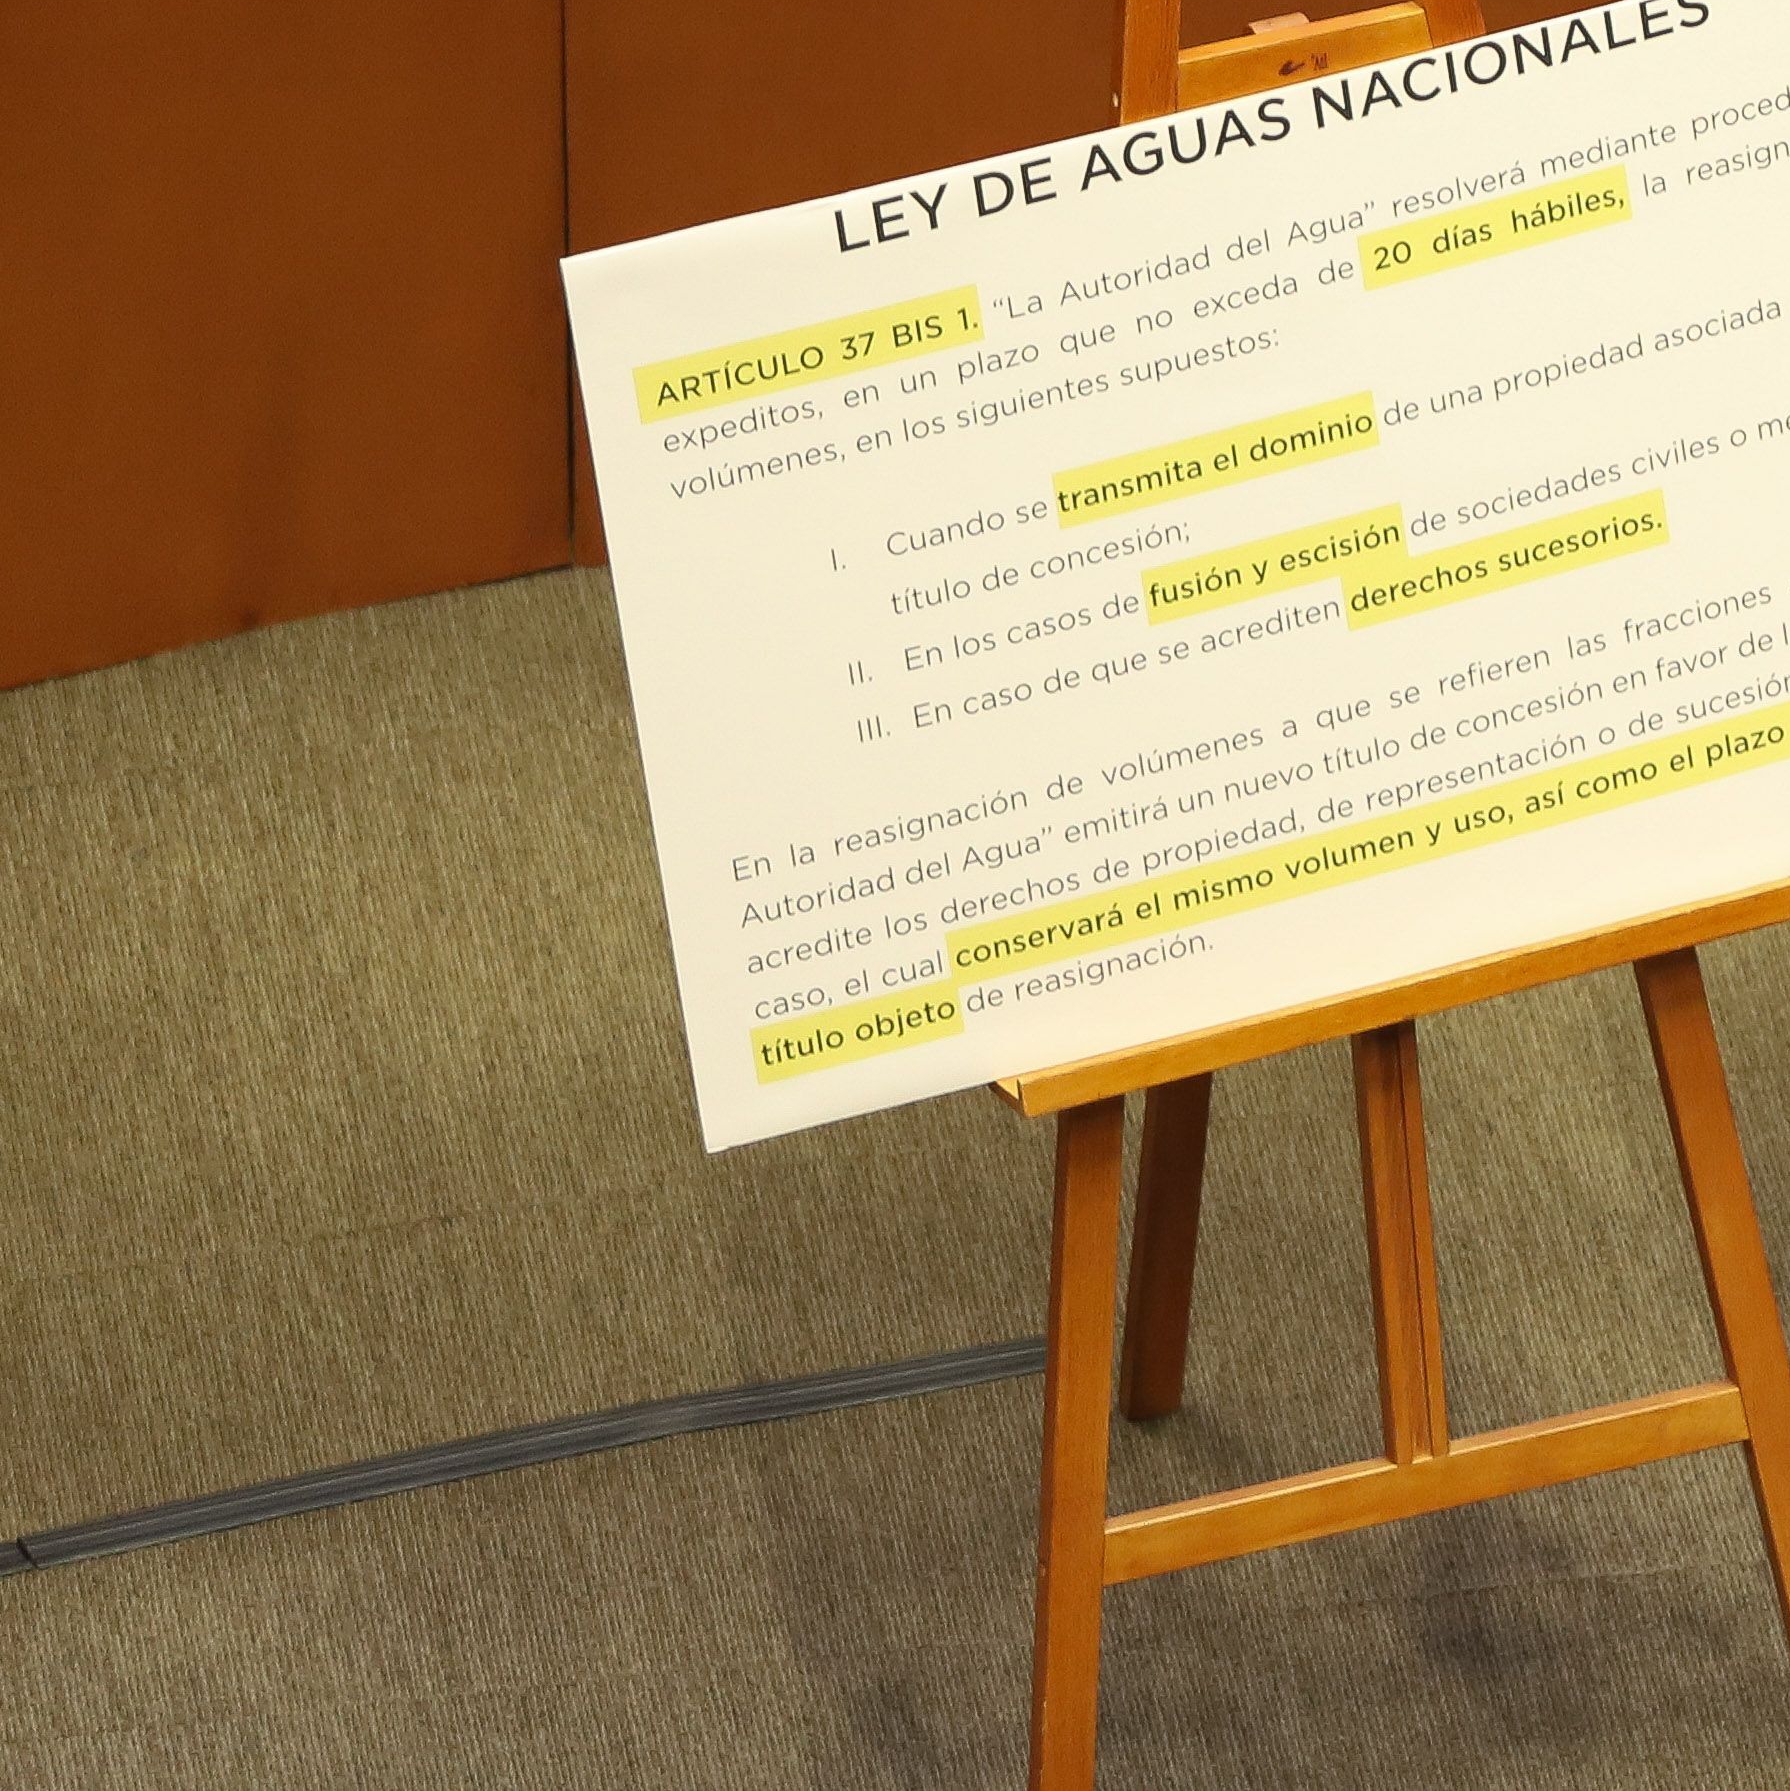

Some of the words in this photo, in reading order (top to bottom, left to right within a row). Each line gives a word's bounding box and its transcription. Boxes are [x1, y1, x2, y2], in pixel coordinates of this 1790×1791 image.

[657, 346, 824, 407] ARTÍCULO
[840, 331, 875, 361] 37
[892, 315, 943, 349] BIS
[957, 307, 978, 331] 1.
[993, 295, 1043, 319] “La
[1060, 244, 1210, 306] Autoridad
[1226, 228, 1270, 261] del
[1288, 201, 1375, 247] Agua”
[1392, 161, 1525, 218] resolverá
[1541, 125, 1676, 177] mediante
[834, 183, 948, 254] LEY
[973, 156, 1058, 218] DE
[1080, 98, 1291, 192] AGUAS
[663, 401, 823, 453] expeditos,
[843, 385, 880, 408] en
[900, 370, 937, 394] un
[957, 344, 1039, 385] plazo
[1060, 324, 1115, 355] que
[1136, 310, 1173, 334] no
[1193, 274, 1298, 318] exceda
[1318, 259, 1354, 285] de
[1374, 240, 1412, 271] 20
[1432, 223, 1493, 254] días
[1511, 189, 1624, 233] hábiles,
[1642, 174, 1667, 197] la
[857, 715, 891, 743] III.
[913, 702, 952, 729] En
[963, 683, 1032, 715] caso
[1043, 668, 1080, 694] de
[1091, 653, 1147, 684] que
[1158, 641, 1189, 664] se
[1201, 601, 1340, 653] acrediten
[1350, 560, 1488, 612] derechos
[1498, 513, 1662, 572] sucesorios.
[891, 578, 971, 615] título
[982, 564, 1019, 592] de
[1030, 522, 1190, 579] concesión;
[755, 987, 833, 1020] caso,
[844, 969, 869, 996] el
[882, 950, 943, 987] cual
[956, 902, 1124, 968] conservará
[1135, 892, 1161, 920] el
[1173, 869, 1274, 911] mismo
[1284, 830, 1414, 879] volumen
[1425, 821, 1441, 846] y
[1454, 805, 1514, 834] uso,
[1525, 780, 1564, 814] así
[1576, 762, 1658, 799] como
[1669, 745, 1694, 772] el
[1706, 726, 1785, 768] plazo
[760, 1028, 844, 1066] título
[855, 1001, 955, 1042] objeto
[966, 986, 1003, 1012] de
[1015, 934, 1213, 1001] reasignación.
